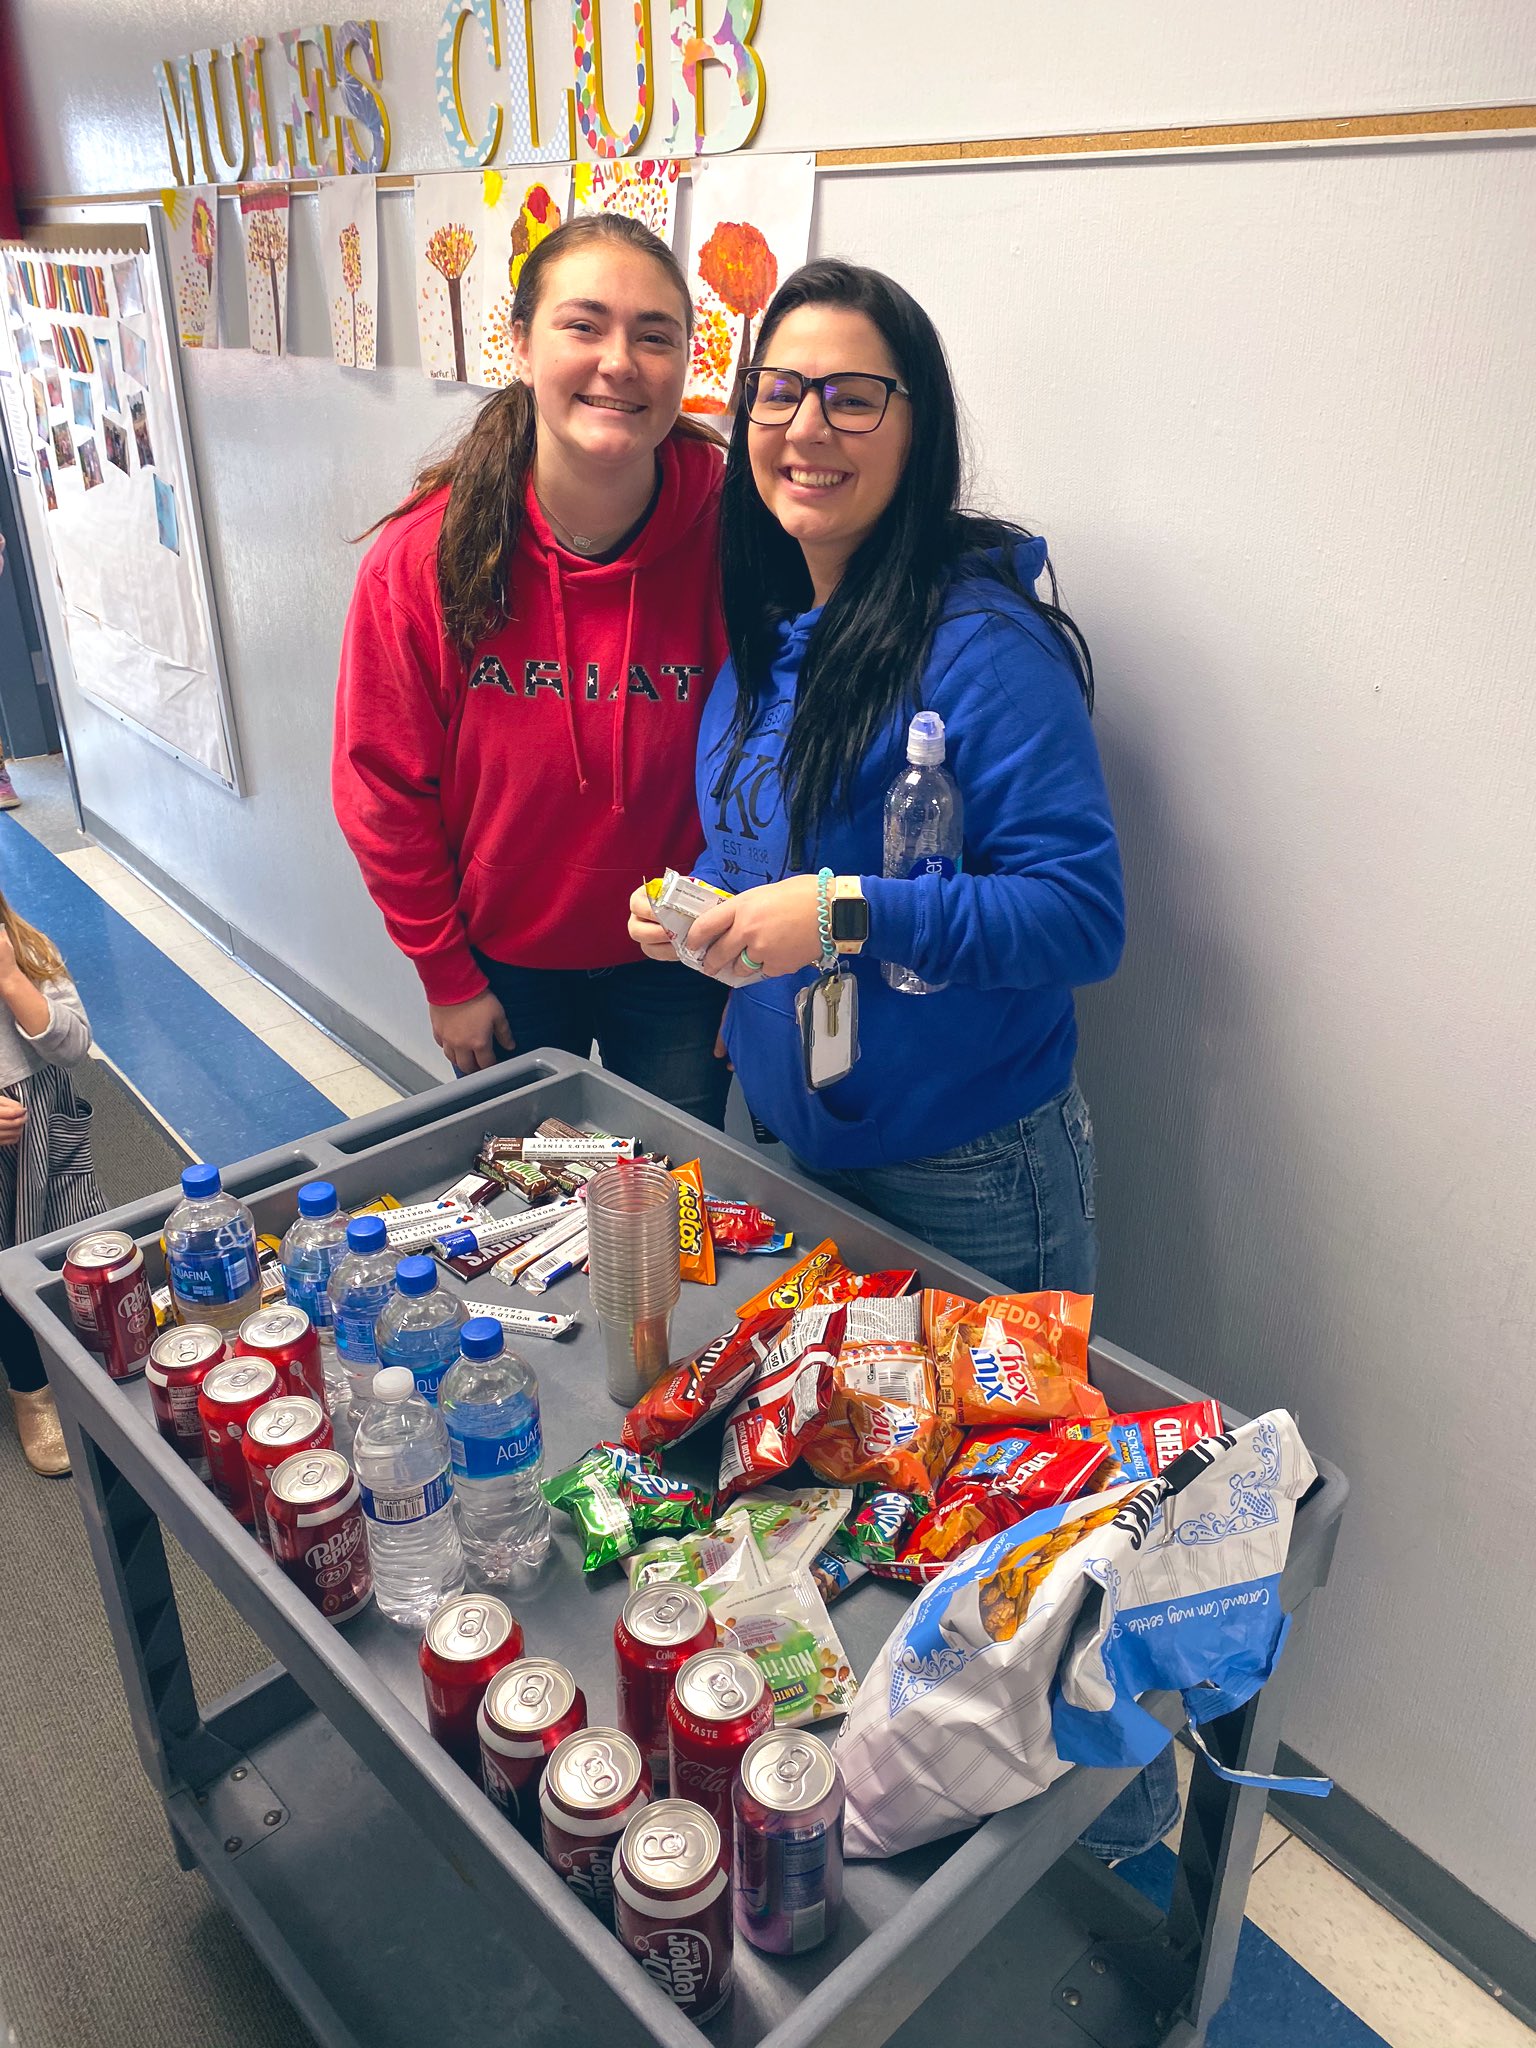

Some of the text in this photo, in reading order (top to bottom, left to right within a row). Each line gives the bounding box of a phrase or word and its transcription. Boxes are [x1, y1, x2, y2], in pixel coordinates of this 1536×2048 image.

[154, 0, 765, 185] MULES CLUB
[470, 654, 703, 702] ARIAT
[714, 751, 782, 841] KC
[722, 838, 742, 856] EST
[677, 1184, 702, 1255] heetos
[173, 1266, 212, 1283] QUAFINA
[490, 1311, 530, 1322] WORLD'S
[978, 1298, 1063, 1347] HEDDAR
[997, 1337, 1038, 1402] Chex
[496, 1422, 539, 1466] AQUAF
[1124, 1429, 1148, 1479] SCRABBLE
[305, 1526, 361, 1570] Pepper
[327, 1526, 350, 1553] Dr
[820, 1557, 840, 1579] Mix
[1168, 1605, 1195, 1625] may
[1220, 1588, 1270, 1616] Caramel
[690, 1724, 719, 1739] TASTE
[641, 1949, 673, 1983] Dr
